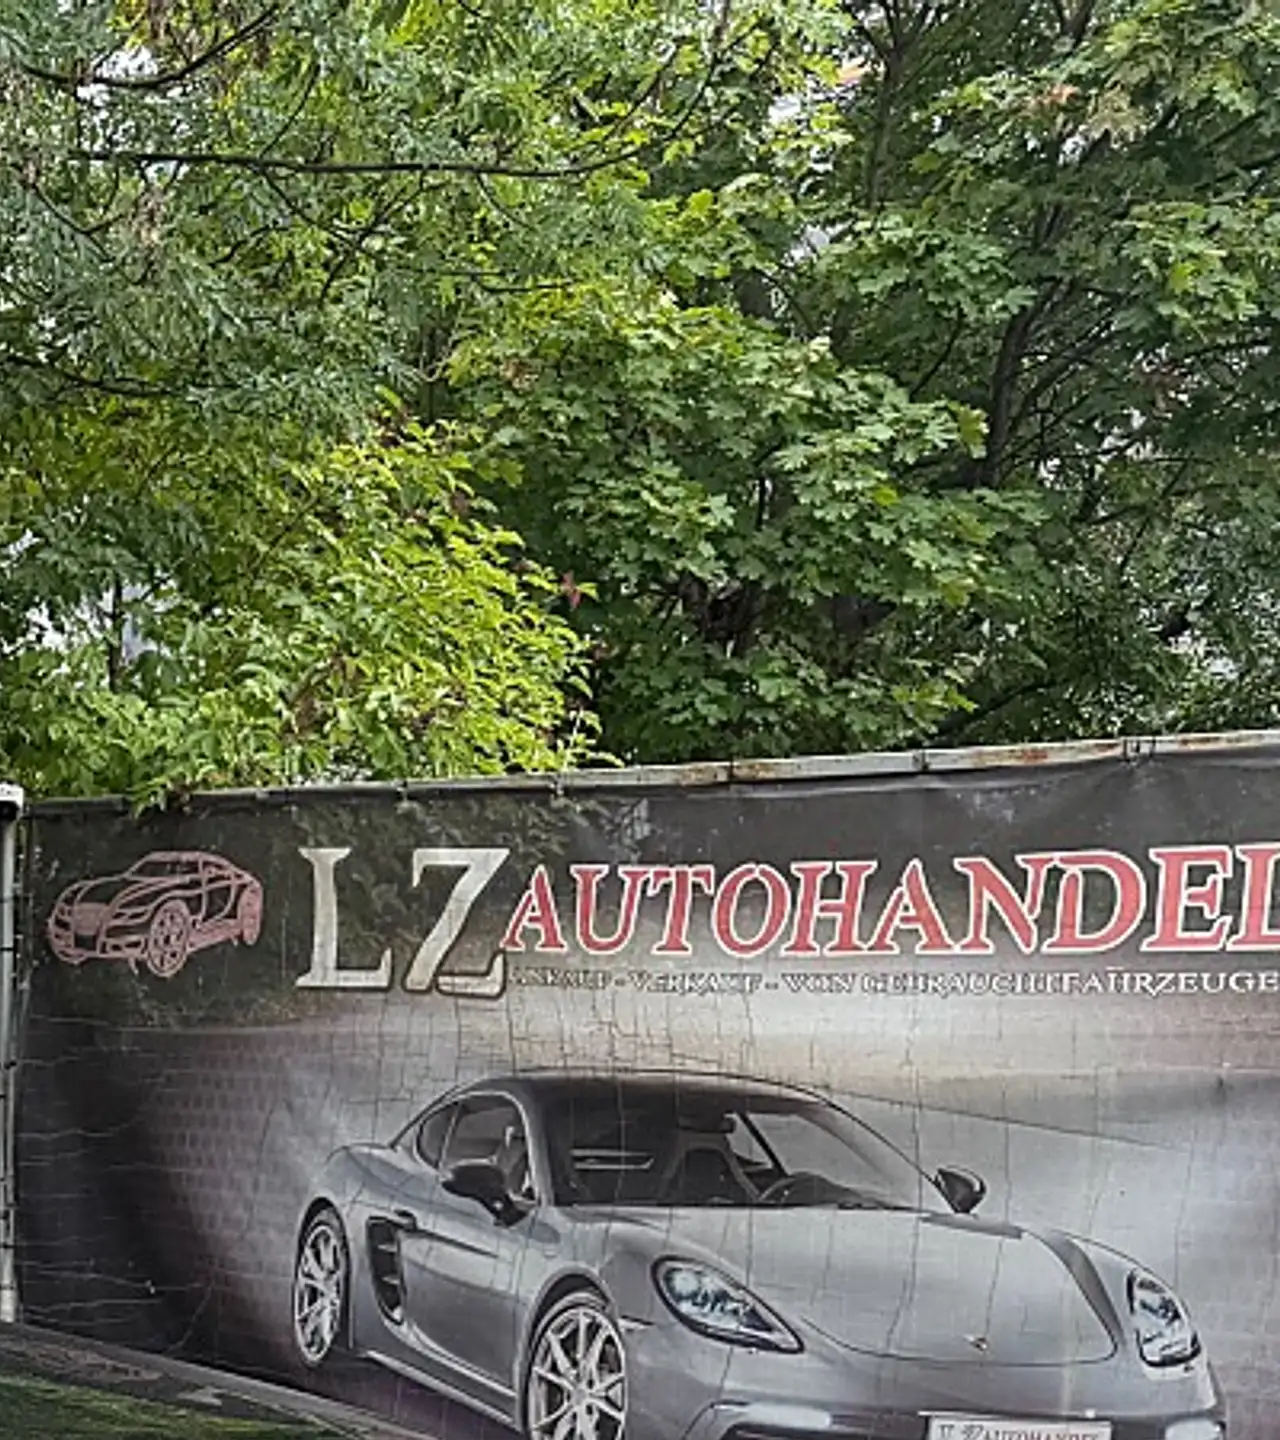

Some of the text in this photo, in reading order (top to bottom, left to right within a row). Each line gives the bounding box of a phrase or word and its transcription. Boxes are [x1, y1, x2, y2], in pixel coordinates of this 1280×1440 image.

[504, 843, 1280, 956] AUTOHANDEL
[628, 969, 763, 997] VERKAUF
[782, 971, 856, 994] VON
